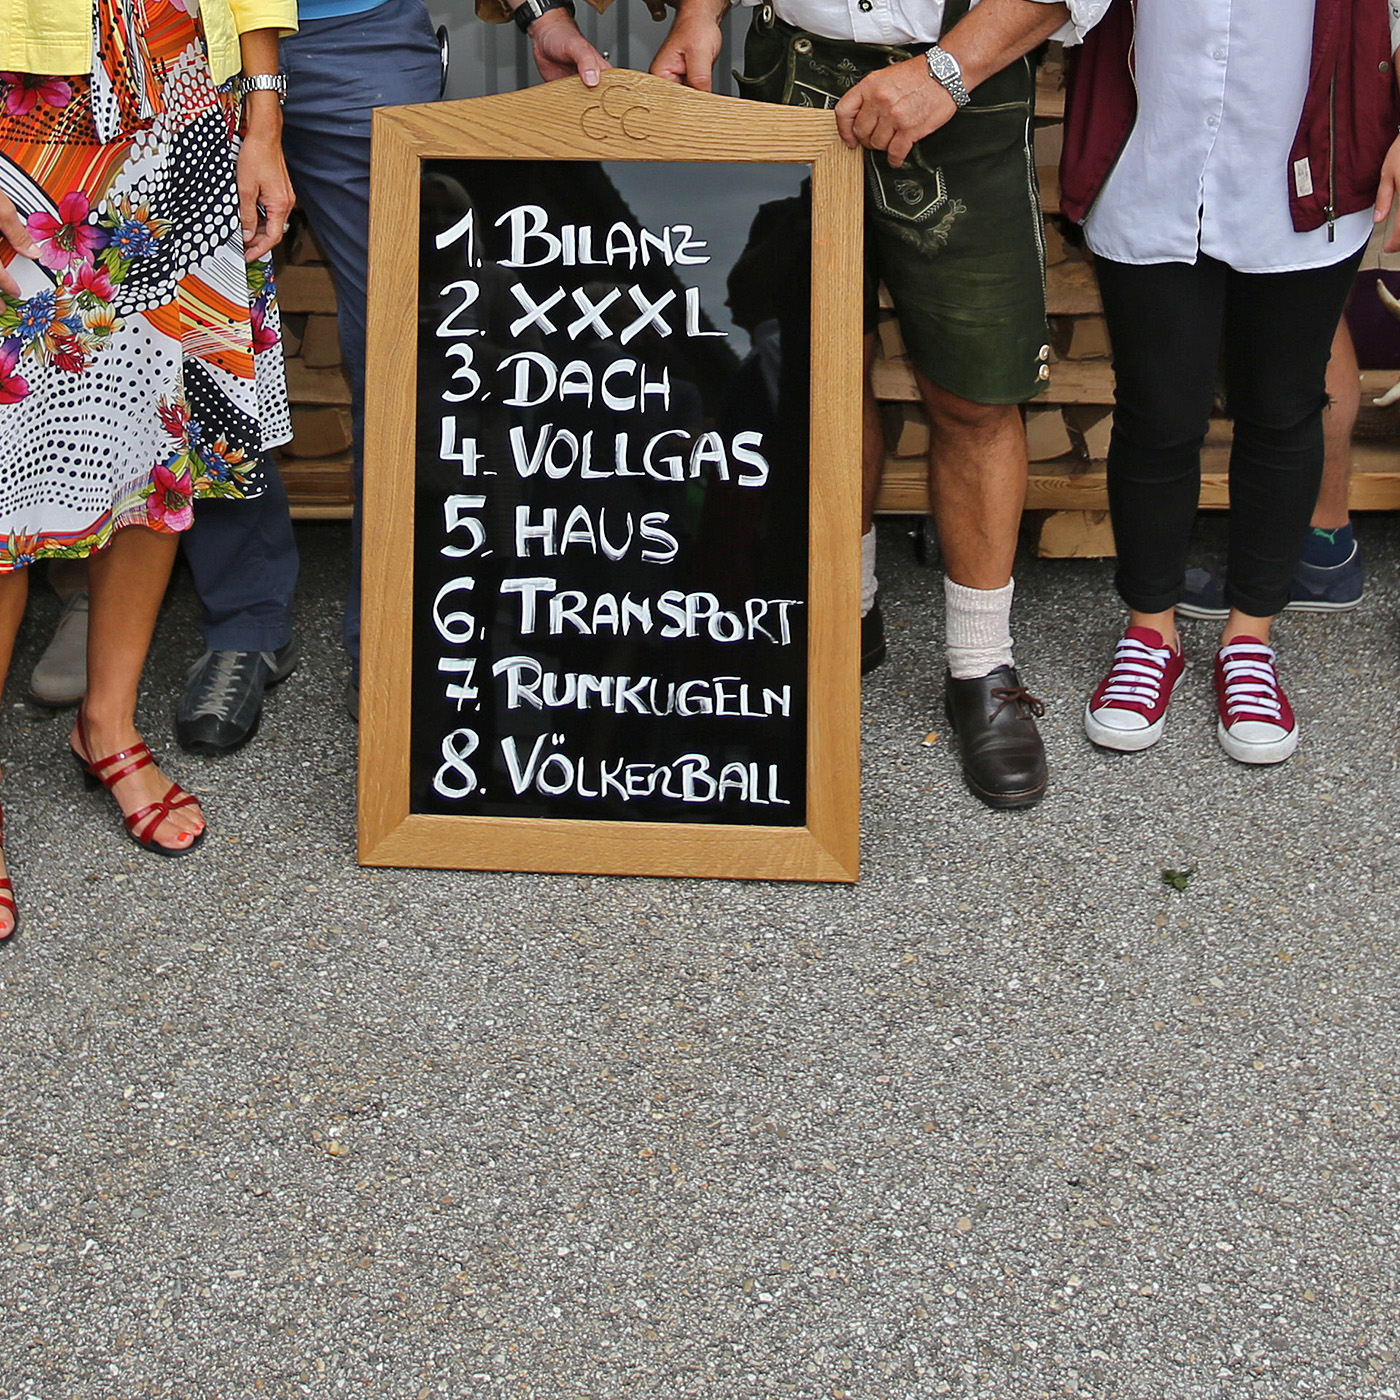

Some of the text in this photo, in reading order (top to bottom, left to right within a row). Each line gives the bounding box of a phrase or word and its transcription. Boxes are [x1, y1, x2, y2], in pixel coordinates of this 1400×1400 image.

[435, 204, 712, 270] 1. BILANZ
[435, 279, 729, 346] 2. XXXL
[496, 351, 671, 414] DACH
[509, 422, 769, 487] VOLLGAS
[515, 504, 679, 565] HAUS
[432, 576, 804, 646] 6. TRANSPORT
[437, 655, 791, 718] 7. RUMKUGELN
[433, 728, 487, 799] 8.
